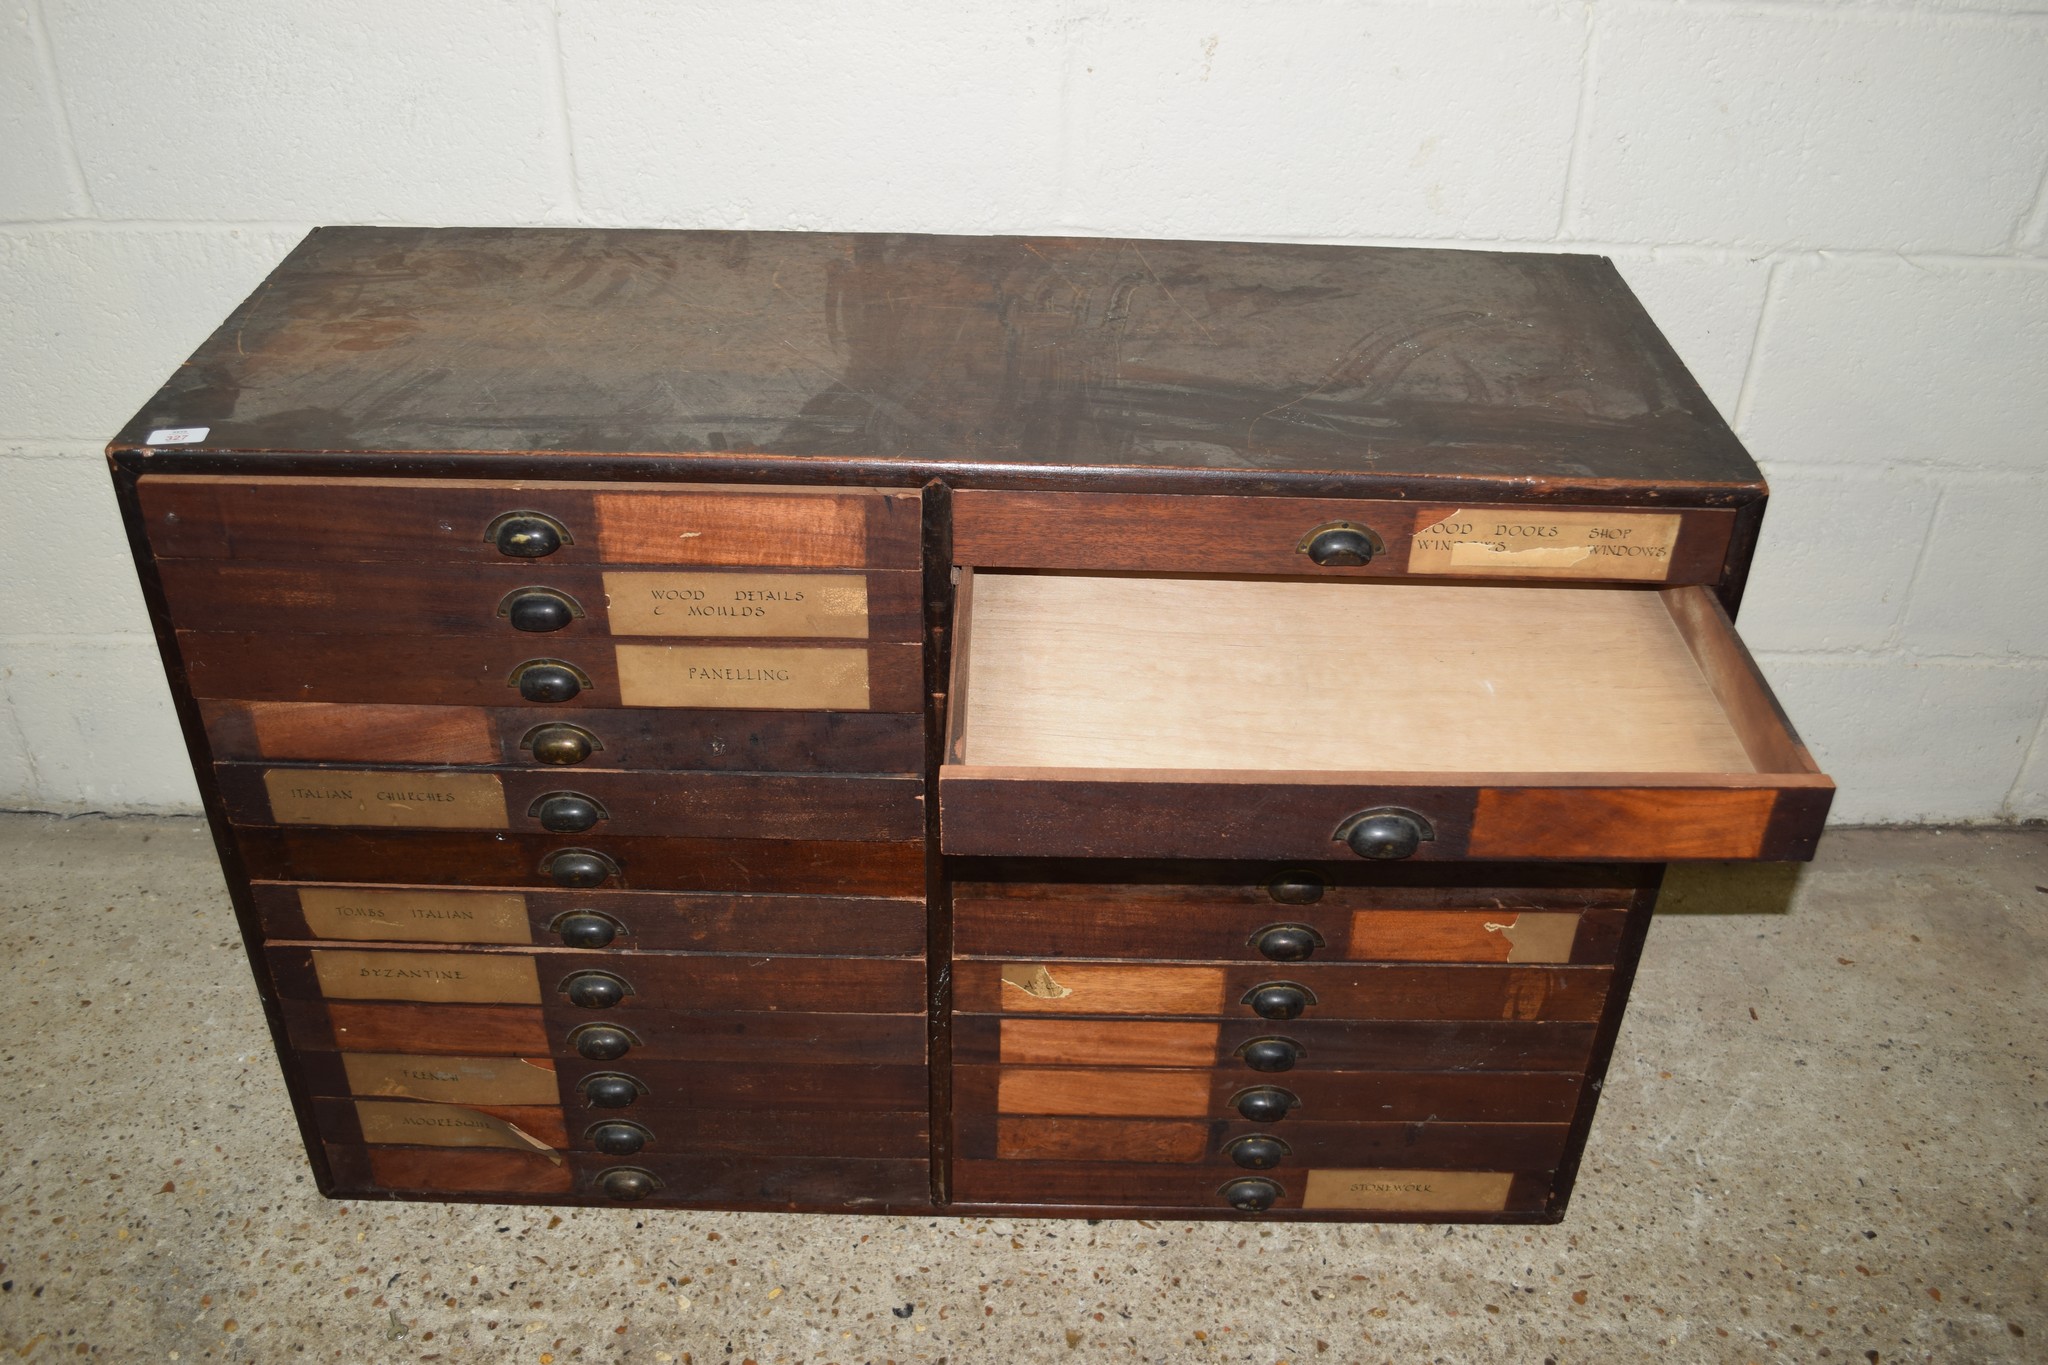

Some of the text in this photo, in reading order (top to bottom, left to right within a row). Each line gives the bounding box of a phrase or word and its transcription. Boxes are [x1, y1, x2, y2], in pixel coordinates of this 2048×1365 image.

[1423, 523, 1632, 539] OOD DOORS SHOP
[1417, 539, 1667, 558] WINS WINDOWS
[651, 589, 805, 602] WOOD DETAILS
[687, 605, 766, 617] MOULDS
[688, 666, 790, 682] PANELLING
[290, 788, 456, 803] ITALIAN CHURCHES
[335, 907, 474, 920] TOMBS ITALIAN
[360, 967, 468, 980] BYZANTINE
[402, 1069, 459, 1082] FRENCH
[1350, 1183, 1433, 1193] STONEWORK
